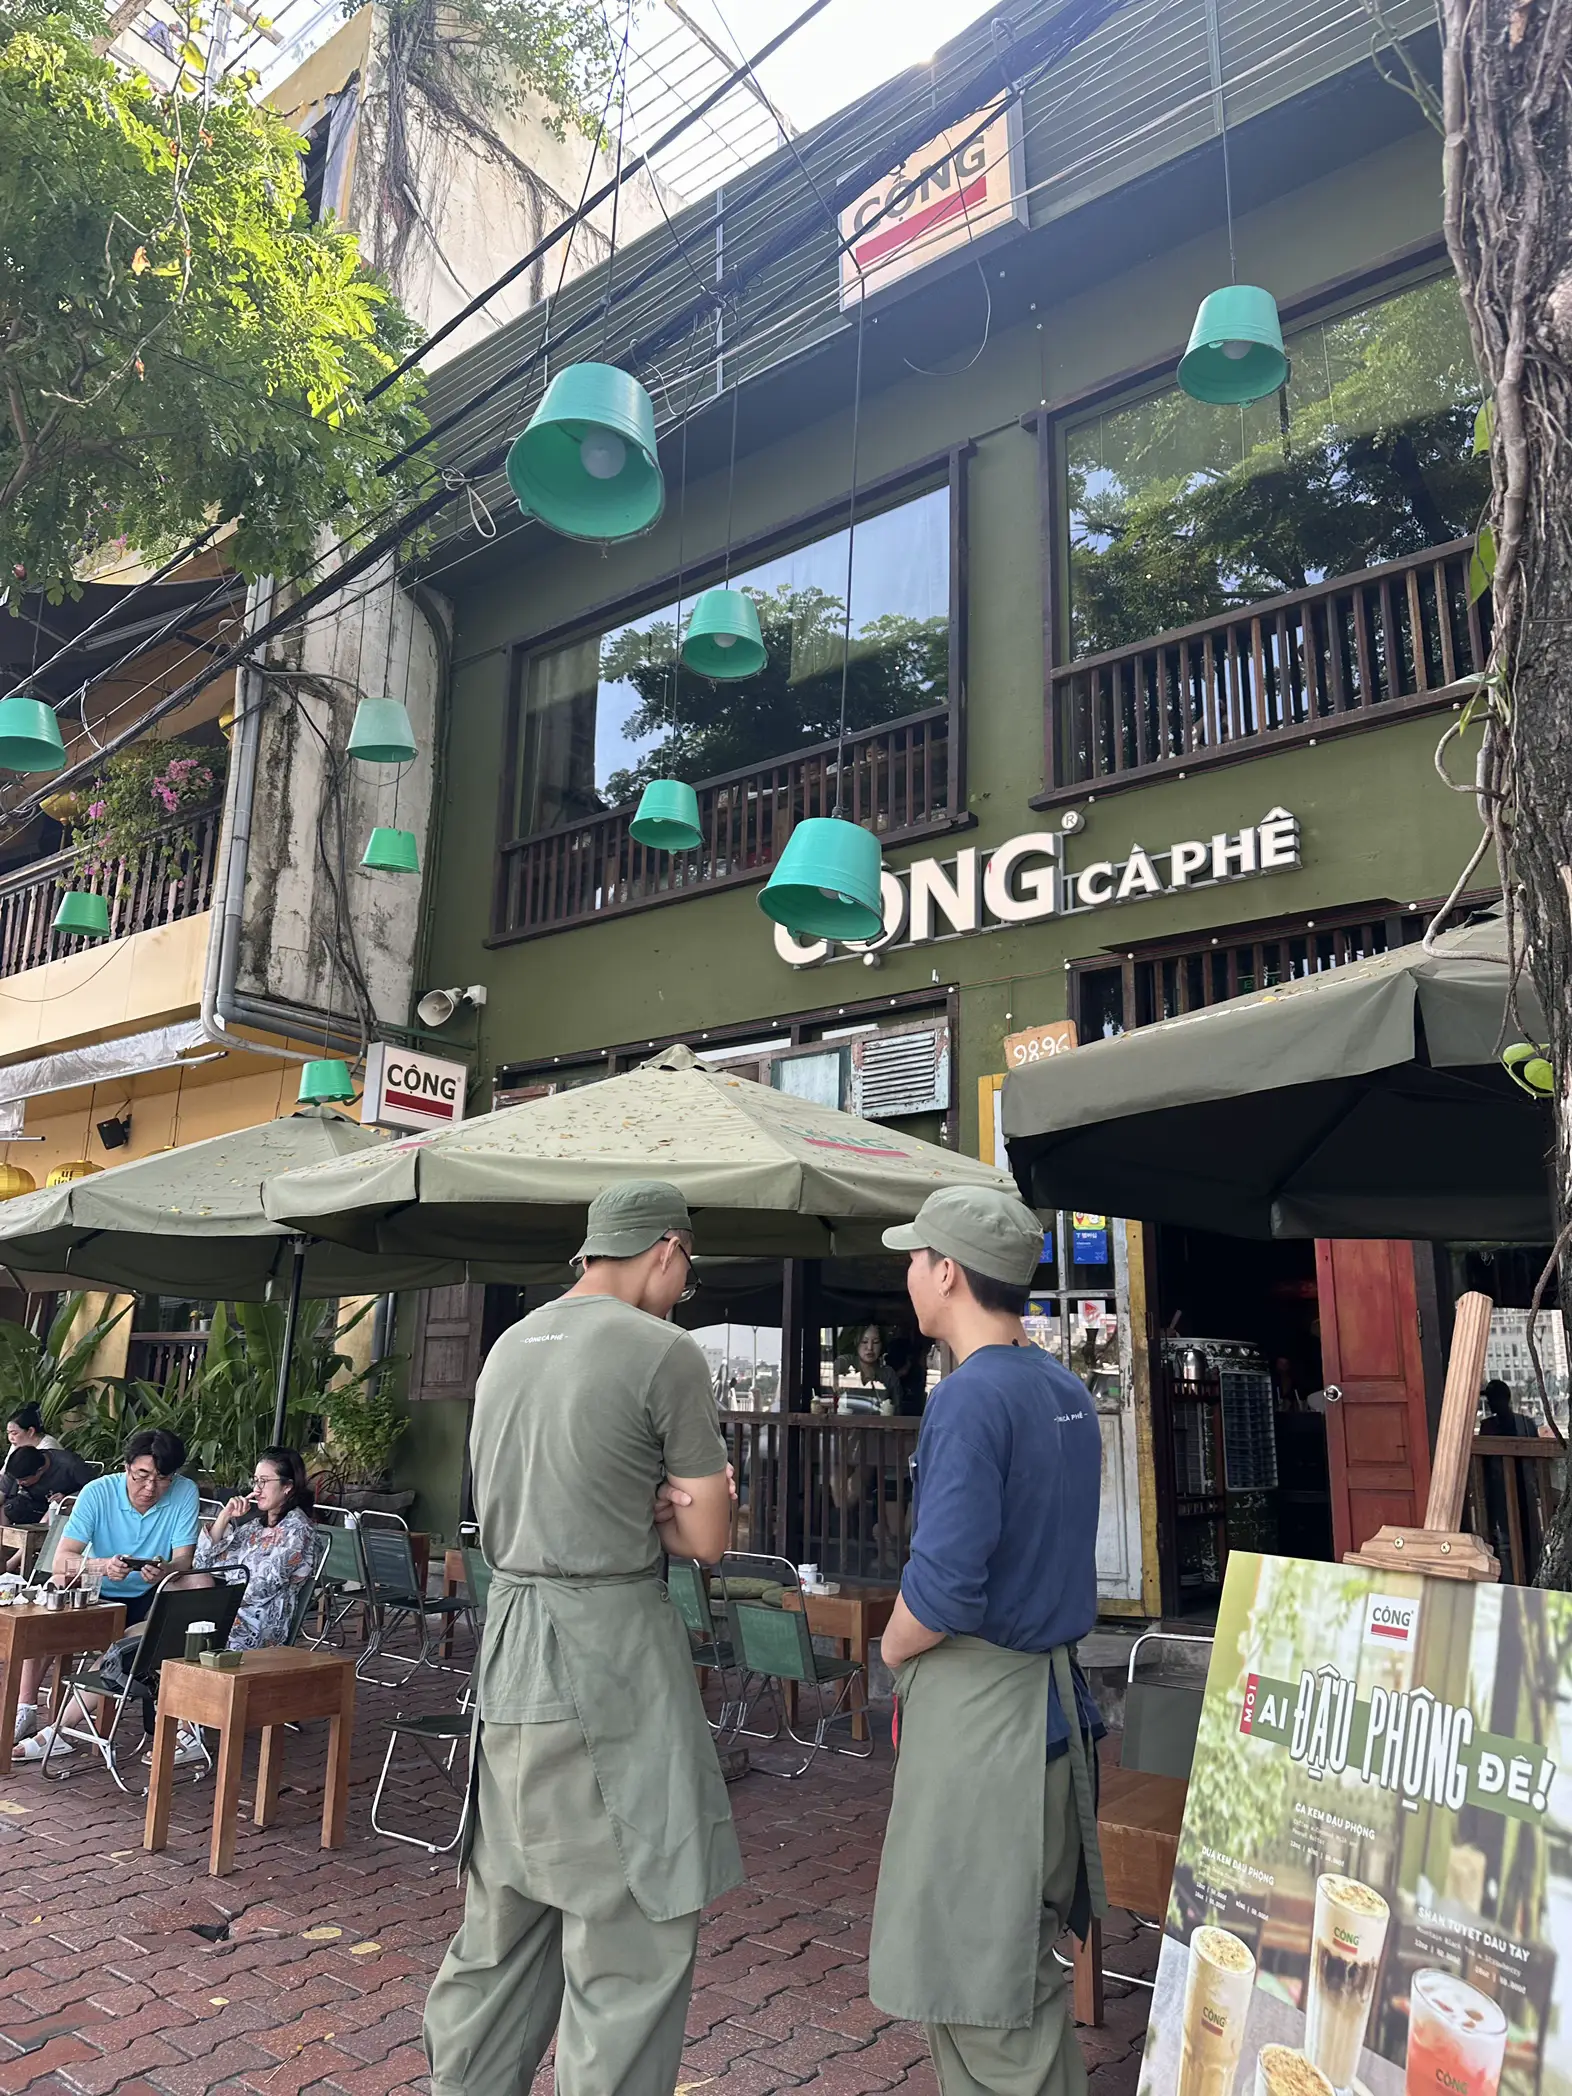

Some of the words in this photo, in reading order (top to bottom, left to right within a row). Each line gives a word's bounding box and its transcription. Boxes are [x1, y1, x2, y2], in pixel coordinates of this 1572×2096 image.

[1170, 806, 1301, 888] PHÊ
[1013, 1033, 1071, 1066] 98-96
[387, 1063, 457, 1100] CỘNG
[1257, 1693, 1289, 1731] AI
[1290, 1663, 1357, 1781] ĐẬU
[1361, 1685, 1474, 1813] PHỘNG
